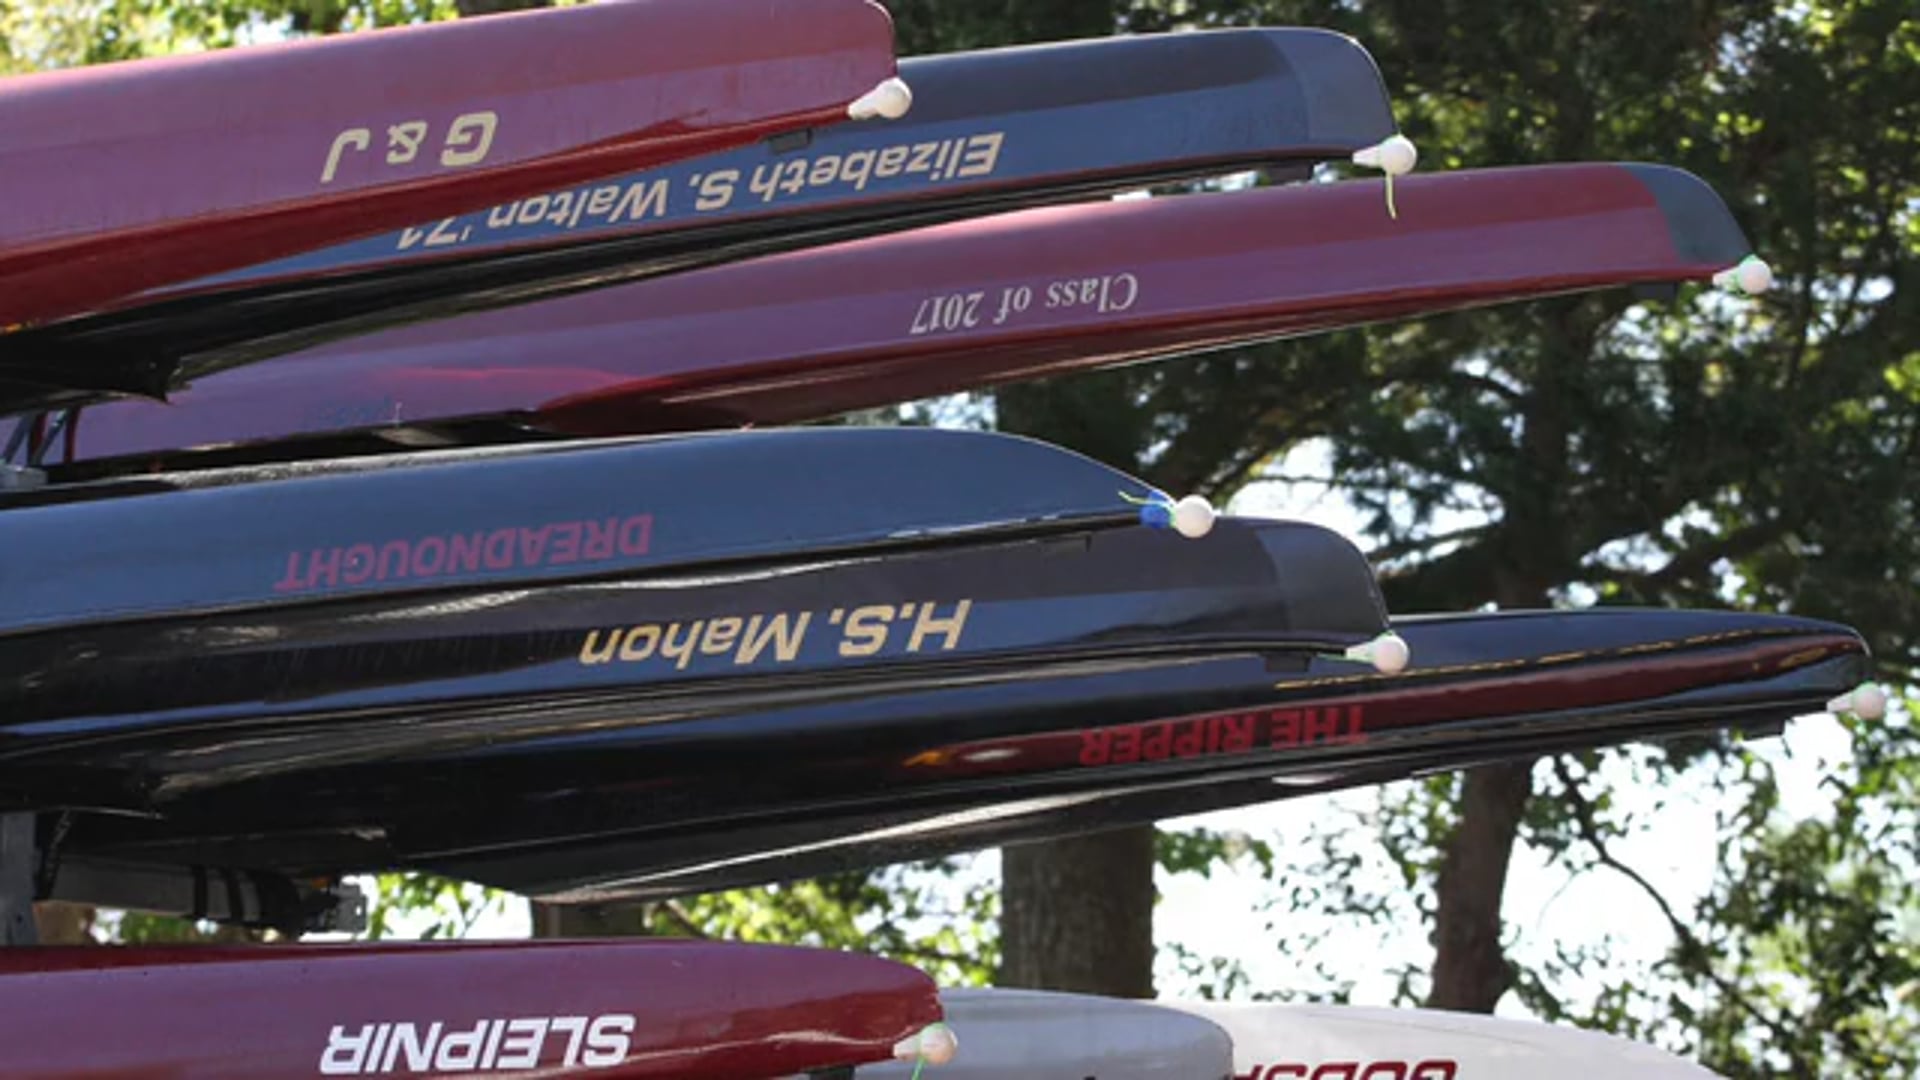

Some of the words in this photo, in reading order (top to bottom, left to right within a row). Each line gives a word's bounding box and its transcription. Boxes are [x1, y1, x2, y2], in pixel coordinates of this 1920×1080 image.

[320, 127, 371, 184] J
[386, 121, 428, 165] &
[440, 110, 498, 167] G
[688, 168, 741, 212] S.
[749, 131, 1005, 203] Elizabeth
[487, 178, 671, 230] Walton
[909, 291, 985, 335] 2017
[992, 286, 1032, 325] of
[1045, 272, 1139, 314] Class
[273, 513, 654, 593] DREADNOUGHT
[577, 610, 813, 671] Mahon
[827, 598, 973, 659] H.S.
[1078, 714, 1256, 768] RIPPER
[1271, 705, 1370, 750] THE
[319, 1013, 637, 1075] SLEIPNIR
